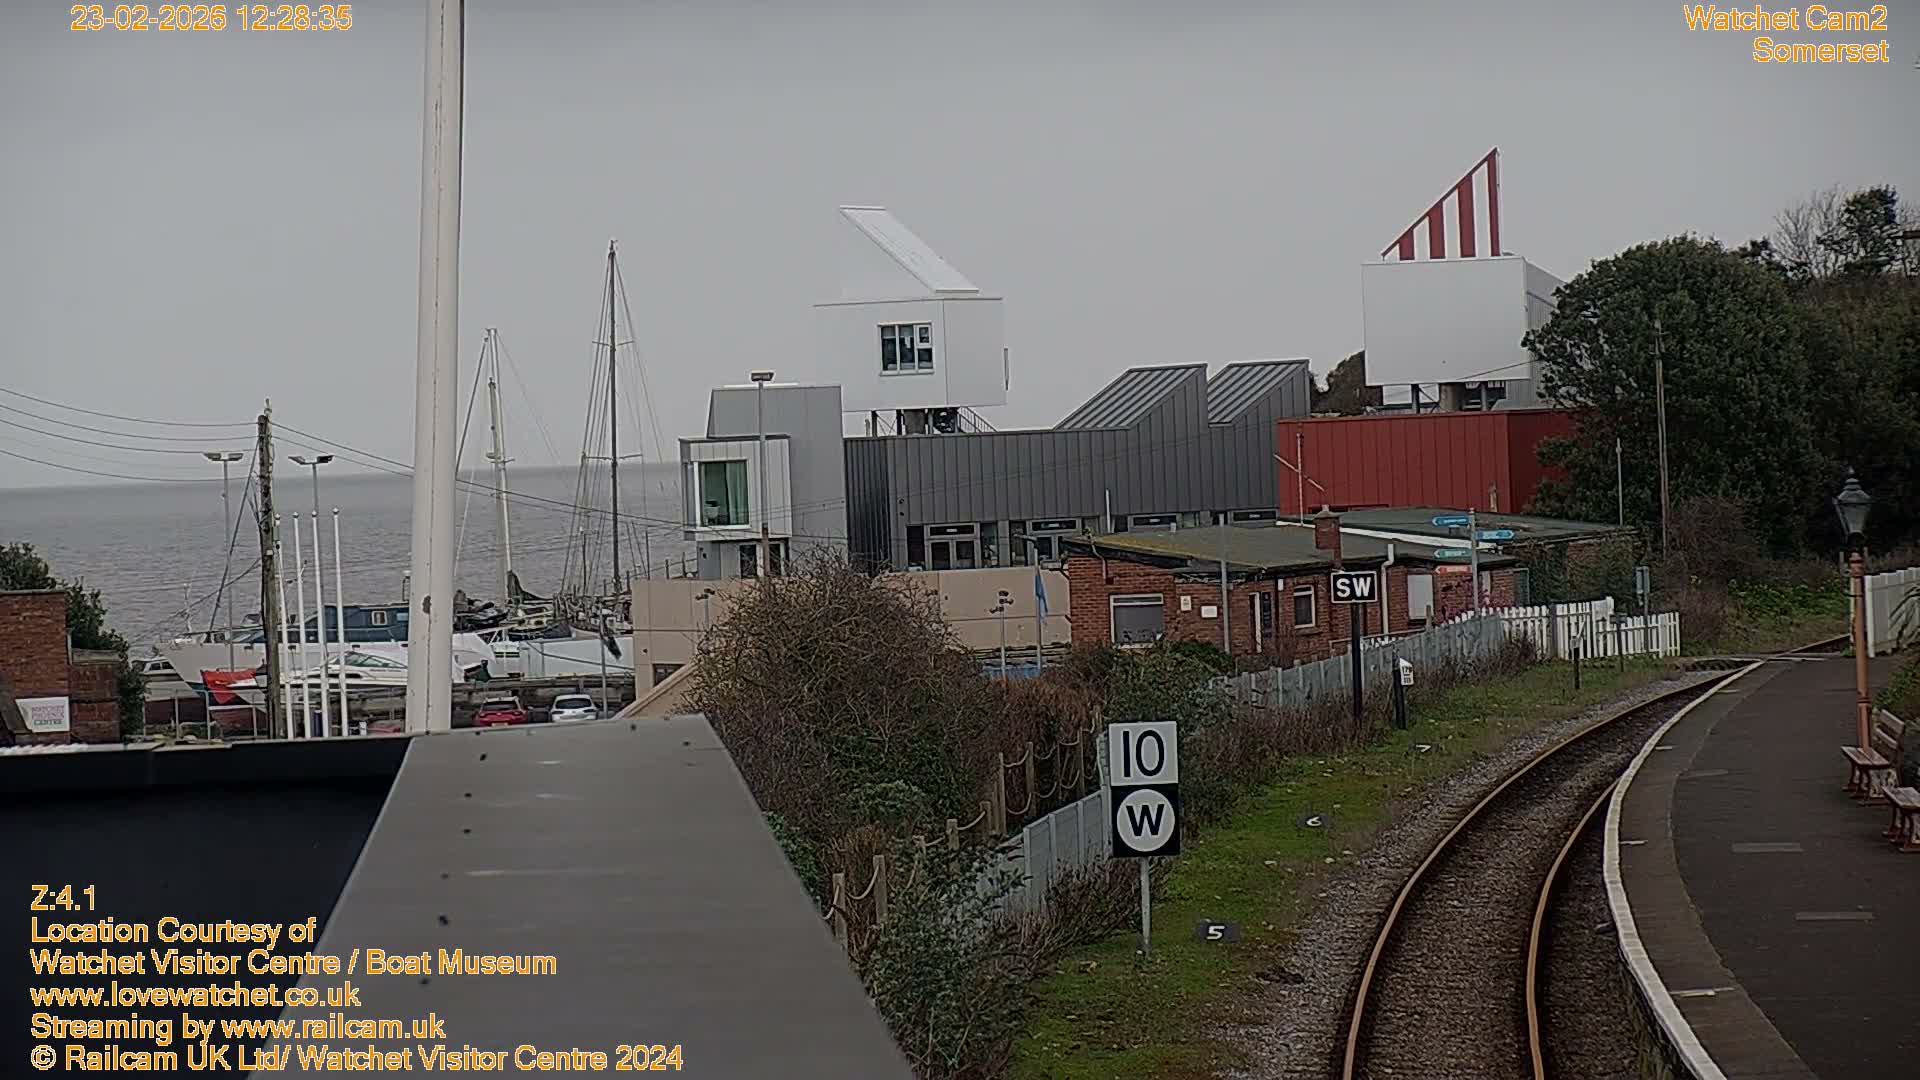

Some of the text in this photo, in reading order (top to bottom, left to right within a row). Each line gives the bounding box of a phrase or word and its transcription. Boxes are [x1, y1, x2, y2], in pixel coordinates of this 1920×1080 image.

[1336, 577, 1371, 598] SW
[1122, 730, 1165, 778] 10
[1416, 744, 1432, 752] 7
[1125, 803, 1165, 837] W
[1306, 816, 1322, 827] 6
[1207, 925, 1225, 940] 5
